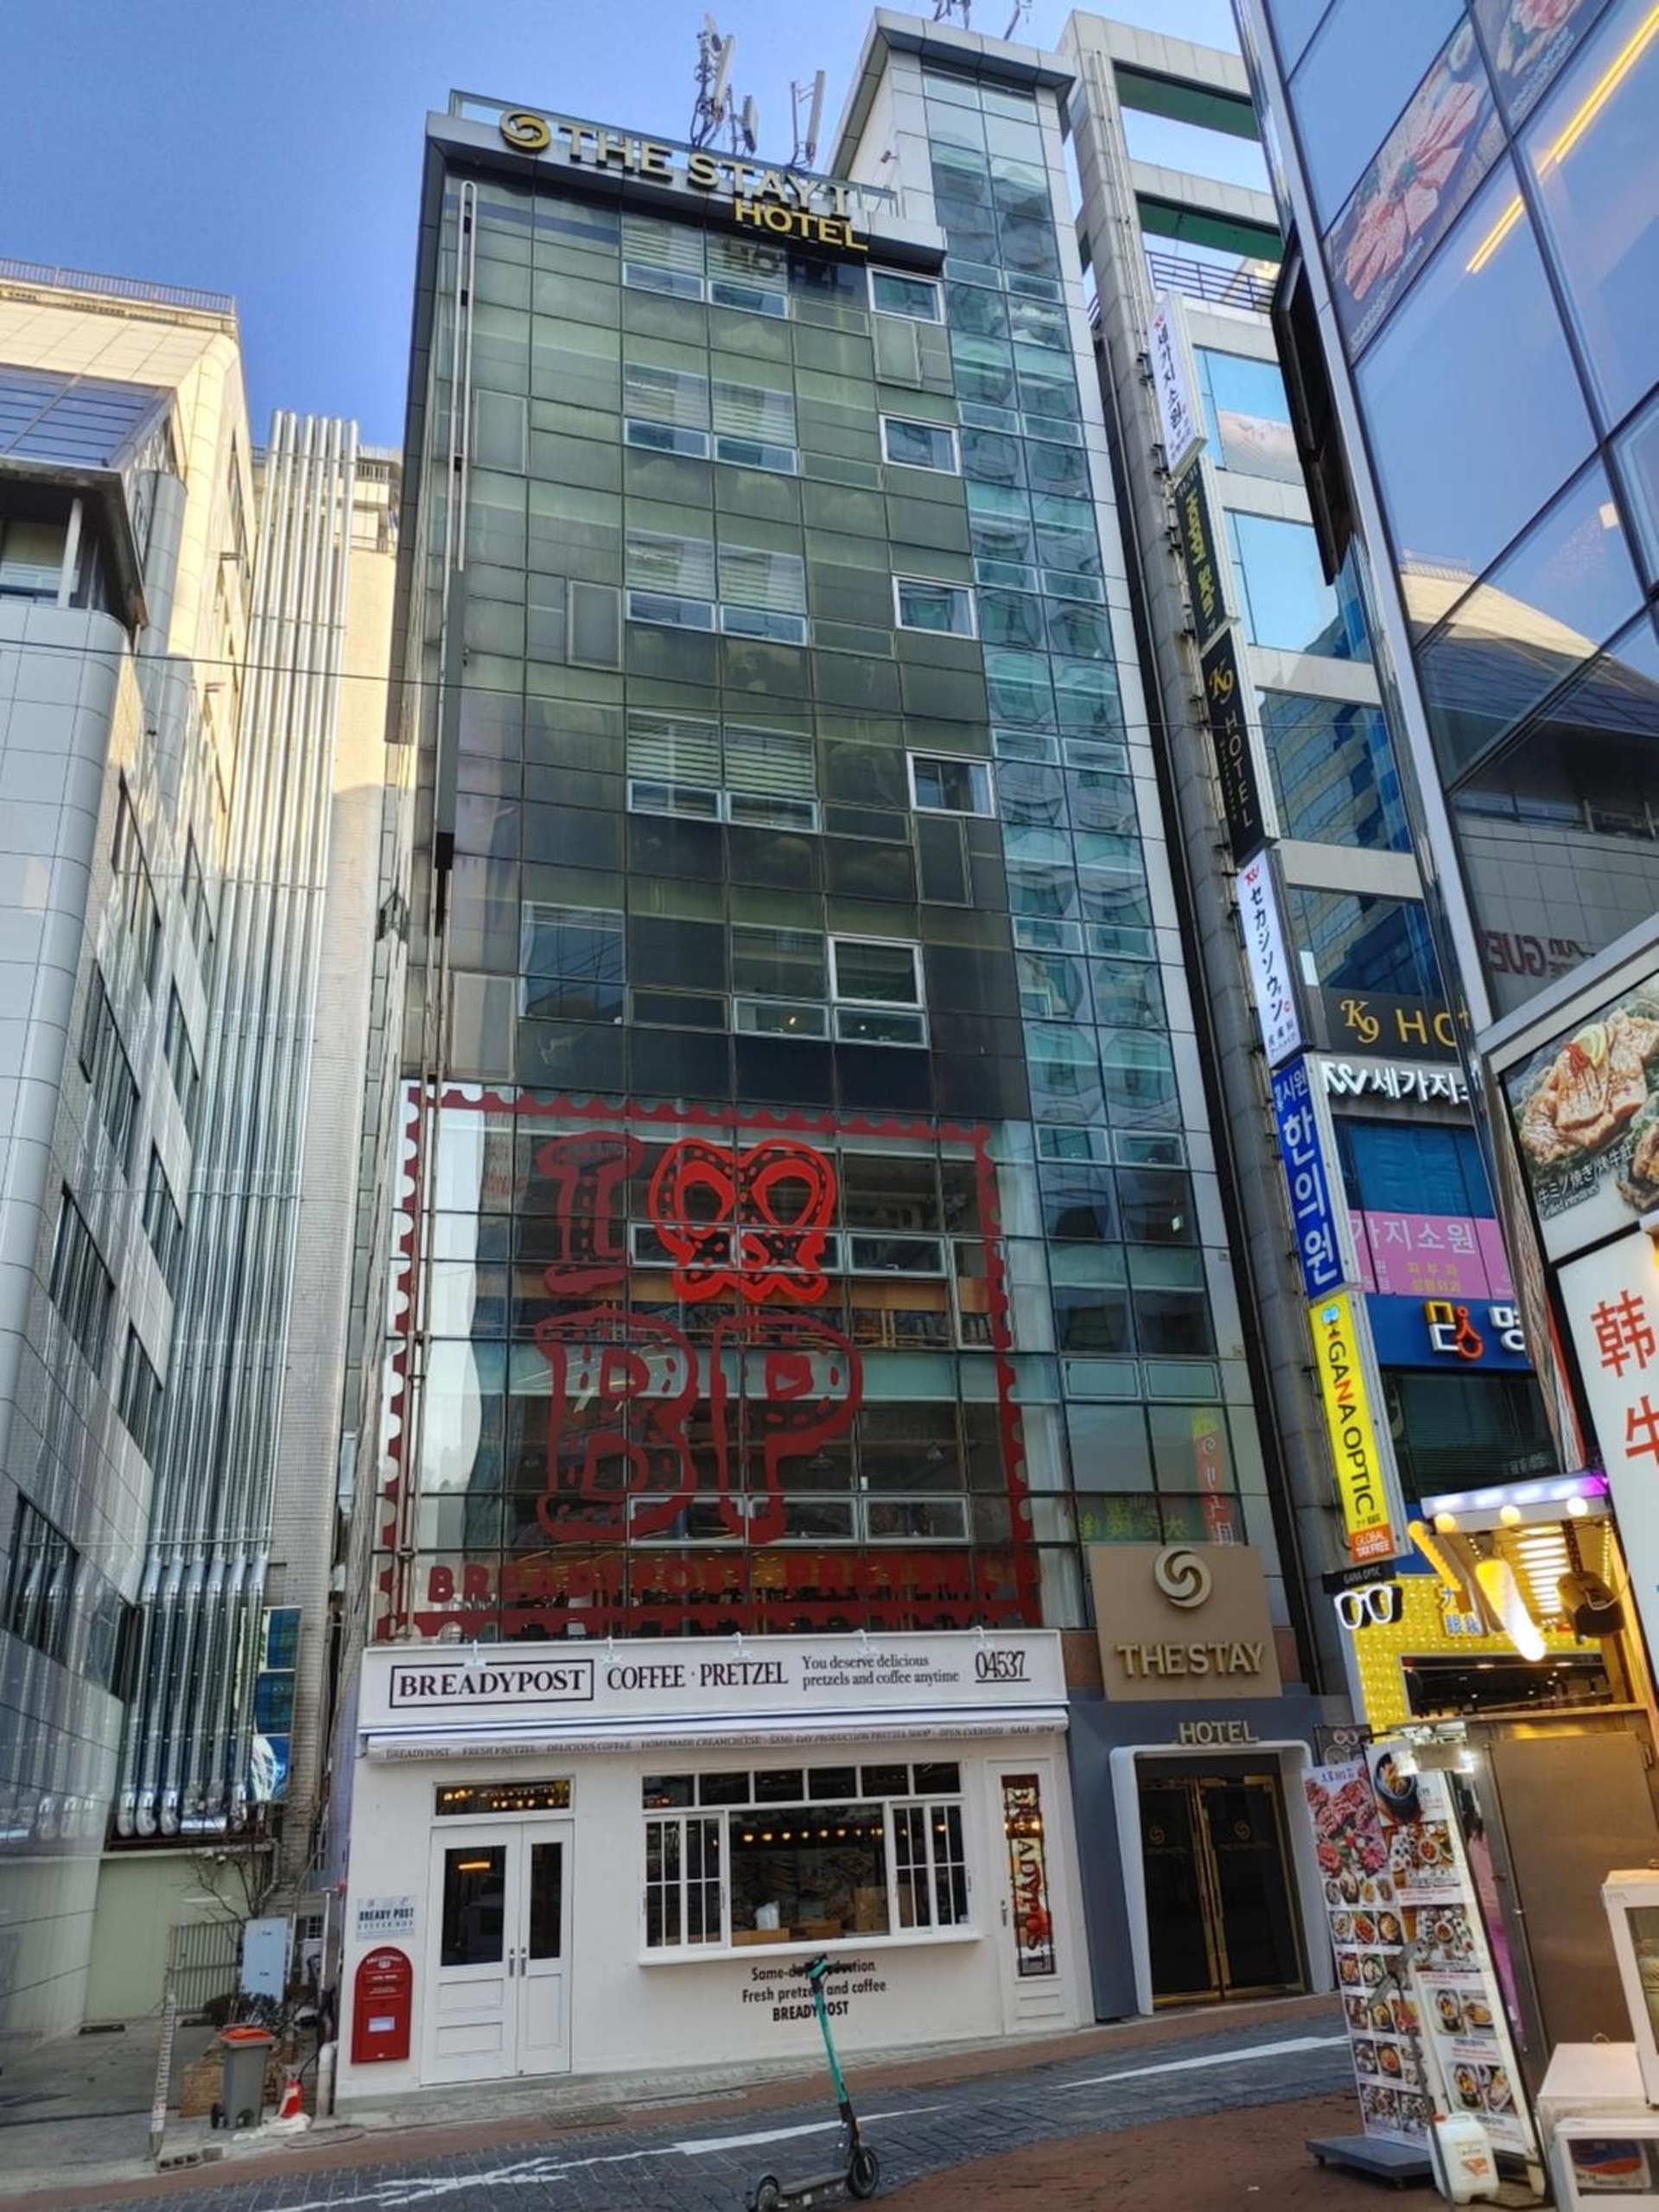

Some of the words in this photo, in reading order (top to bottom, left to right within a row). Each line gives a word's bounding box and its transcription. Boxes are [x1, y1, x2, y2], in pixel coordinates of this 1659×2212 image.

[557, 126, 673, 183] THE
[687, 150, 819, 213] STAY
[734, 198, 868, 251] HOTEL
[1224, 709, 1253, 827] HOTEL
[1284, 1105, 1338, 1287] 한의원
[1328, 1340, 1357, 1424] GANA
[1343, 1427, 1376, 1516] OPTIC
[607, 1664, 685, 1691] COFFEE
[700, 1661, 789, 1687] PRETZEL
[802, 1655, 827, 1670] You
[829, 1655, 874, 1669] deserve
[876, 1653, 930, 1669] delicious
[975, 1650, 1026, 1679] 04537
[398, 1669, 586, 1698] BREADYPOST
[802, 1671, 850, 1691] pretzels
[852, 1671, 874, 1685] and
[875, 1669, 912, 1685] coffee
[913, 1669, 960, 1688] anytime
[1179, 1720, 1261, 1744] HOTEL
[742, 1987, 774, 2003] Fresh
[778, 1984, 823, 2004] pretze
[826, 1980, 849, 1996] and
[851, 1977, 887, 1994] coffee
